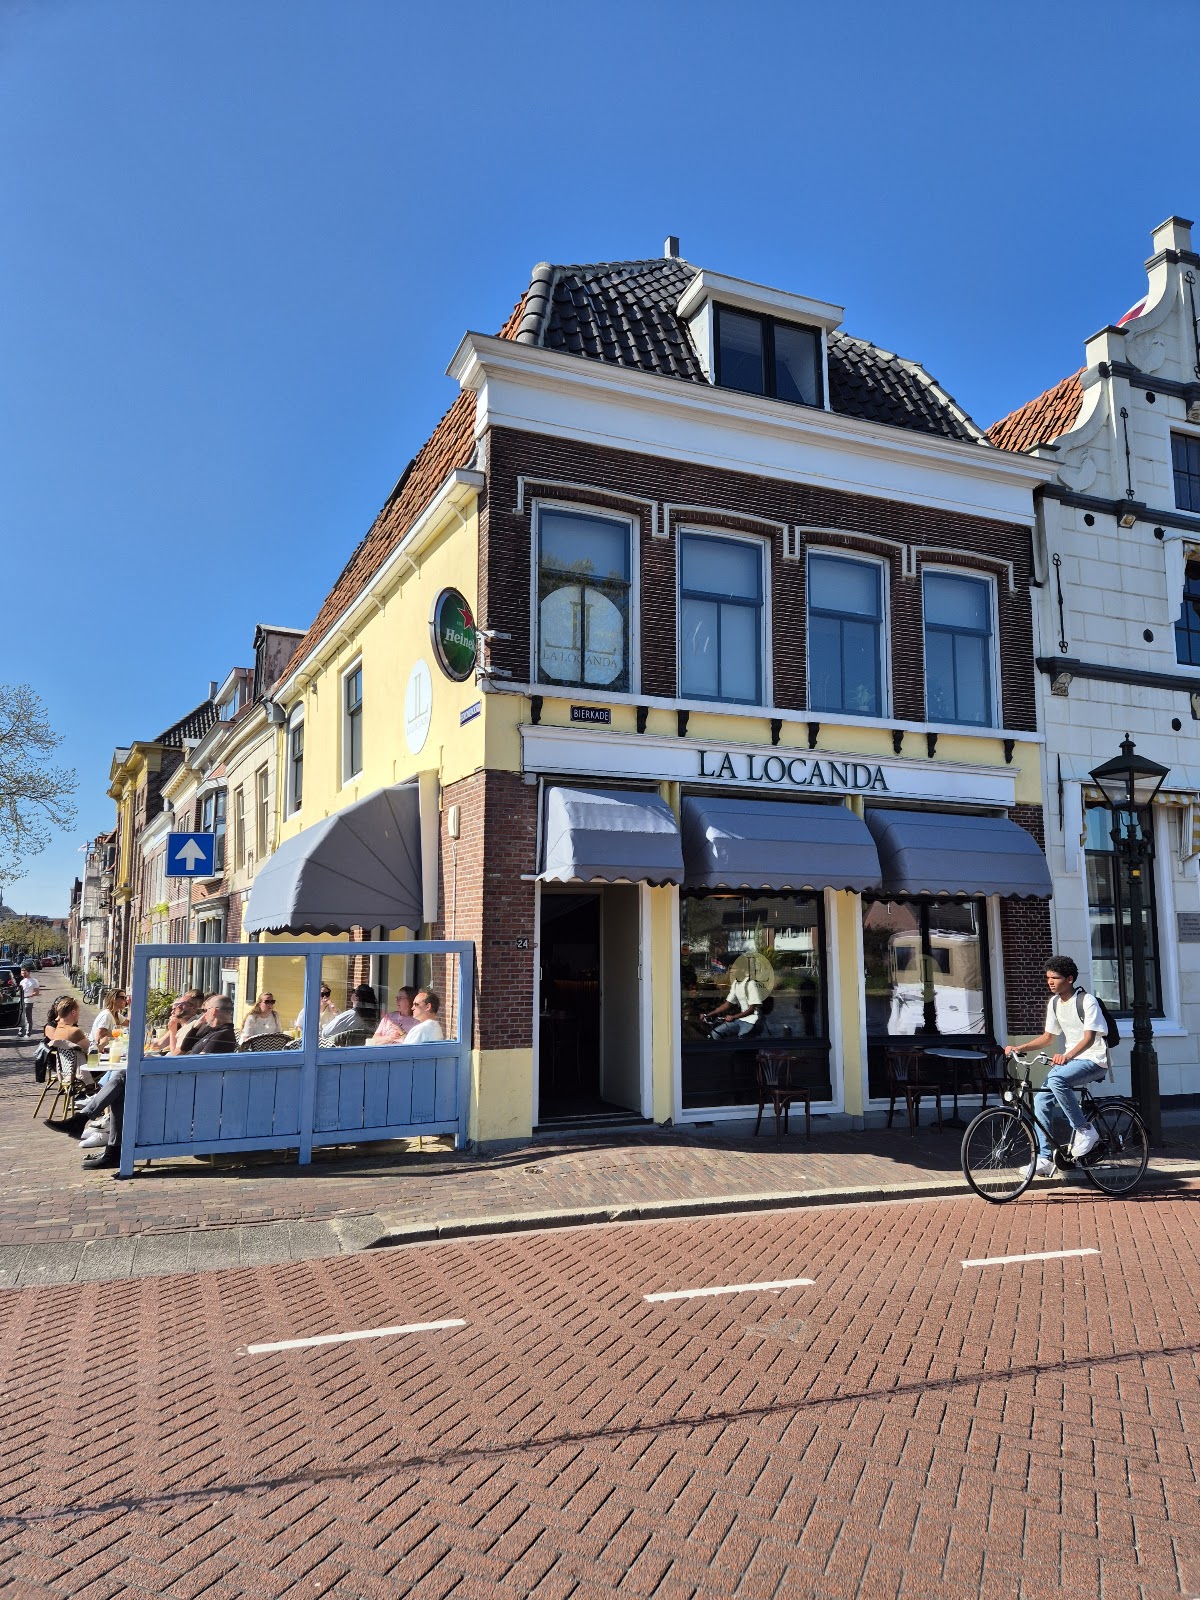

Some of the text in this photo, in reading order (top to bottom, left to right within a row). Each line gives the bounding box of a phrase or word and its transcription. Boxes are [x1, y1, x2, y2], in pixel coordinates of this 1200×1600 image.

[444, 627, 476, 652] Heine
[542, 649, 557, 661] LA
[573, 709, 609, 720] BIERKADE
[697, 750, 890, 791] LA LOCANDA
[517, 939, 528, 949] 24
